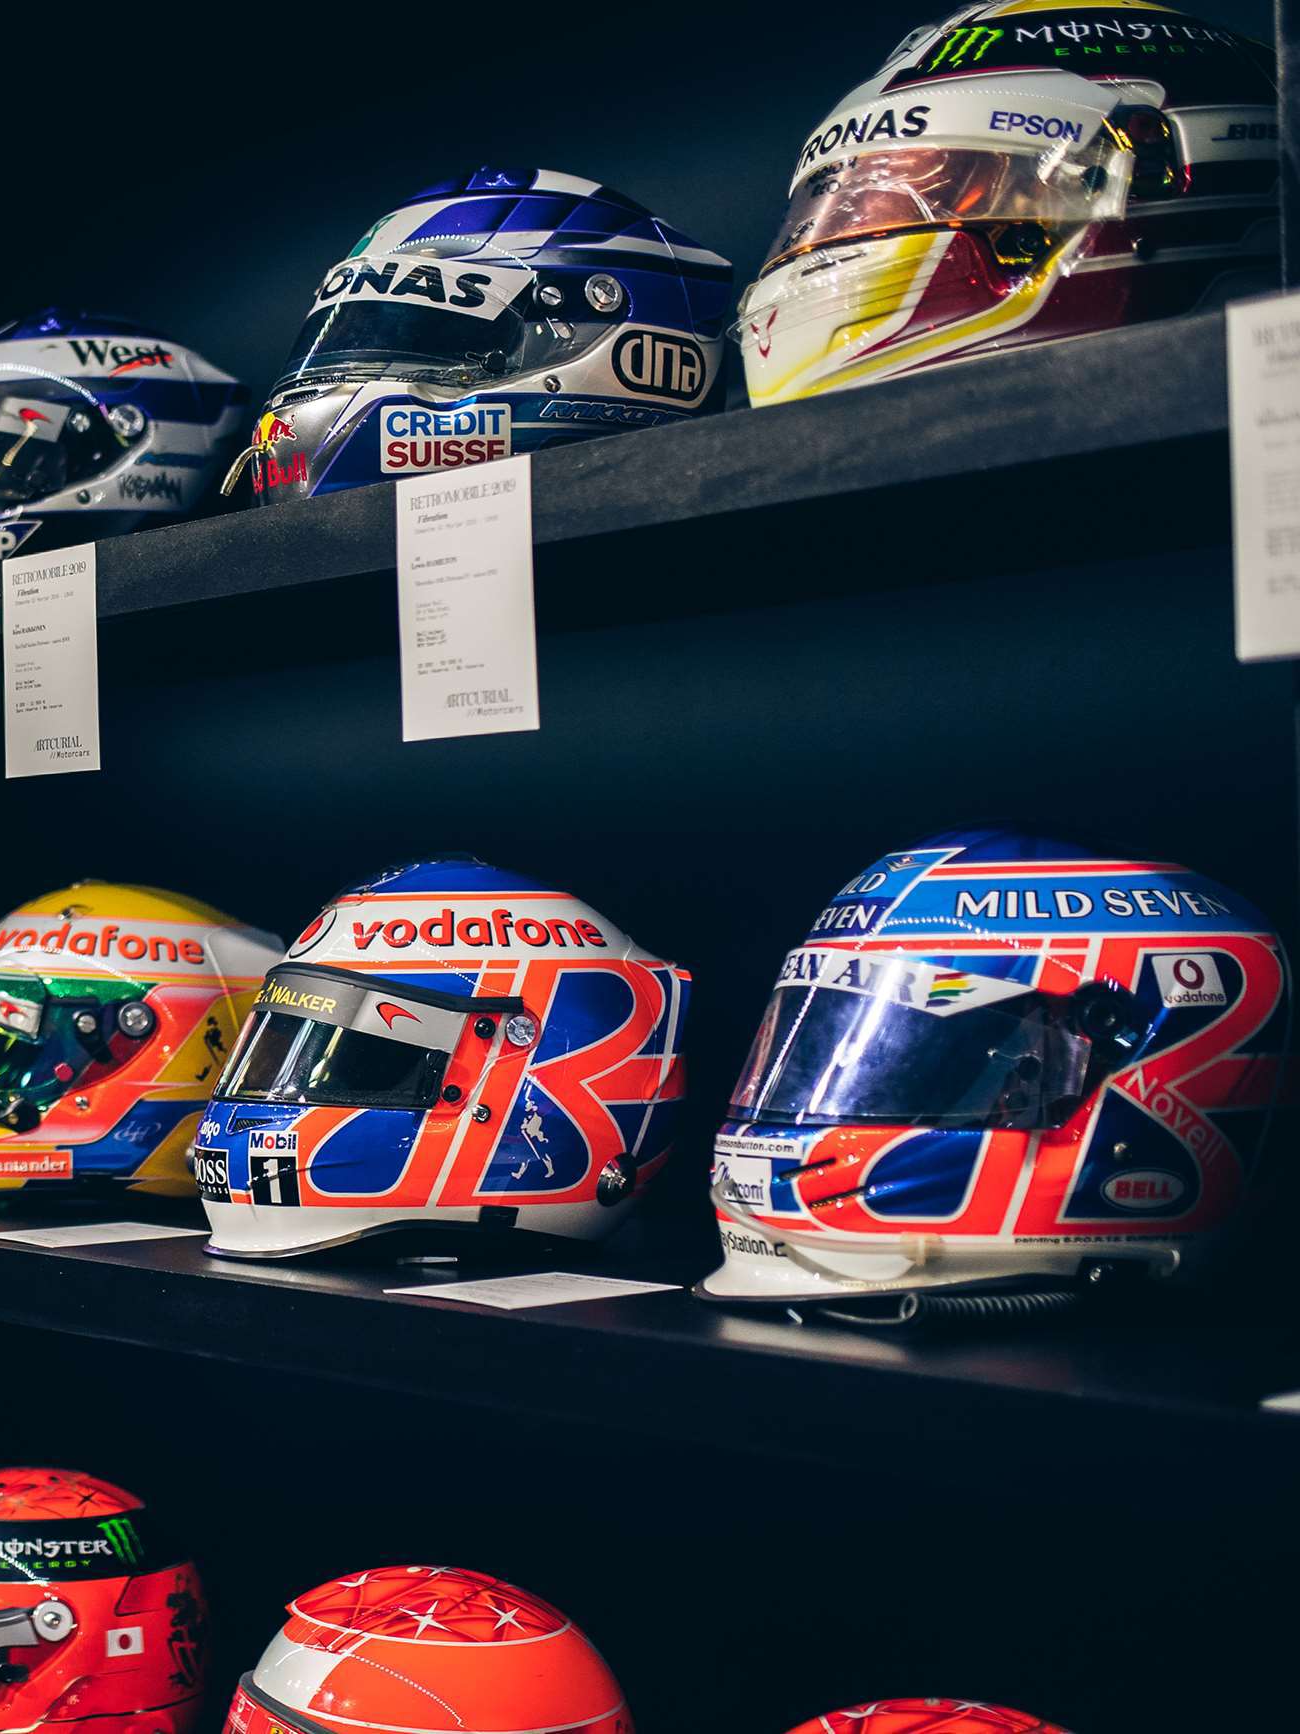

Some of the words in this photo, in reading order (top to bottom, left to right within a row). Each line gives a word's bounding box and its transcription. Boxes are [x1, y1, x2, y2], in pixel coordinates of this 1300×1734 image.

[989, 110, 1083, 143] EPSON
[67, 339, 173, 370] West
[386, 409, 505, 437] CREDIT
[386, 440, 505, 468] SUISSE
[267, 451, 308, 488] Bull
[410, 483, 490, 511] RETROMOBILE
[12, 564, 68, 586] RETROMOBILE
[68, 560, 88, 575] 2019
[35, 735, 83, 752] ARTCURIAL
[955, 889, 1094, 920] MILD
[1101, 887, 1232, 919] SEVEN
[352, 908, 609, 950] vodafone
[270, 985, 337, 1014] WALKER
[1124, 1066, 1224, 1167] Novell
[250, 1132, 297, 1150] Mobil
[262, 1158, 282, 1204] 1
[1113, 1180, 1173, 1200] BELL
